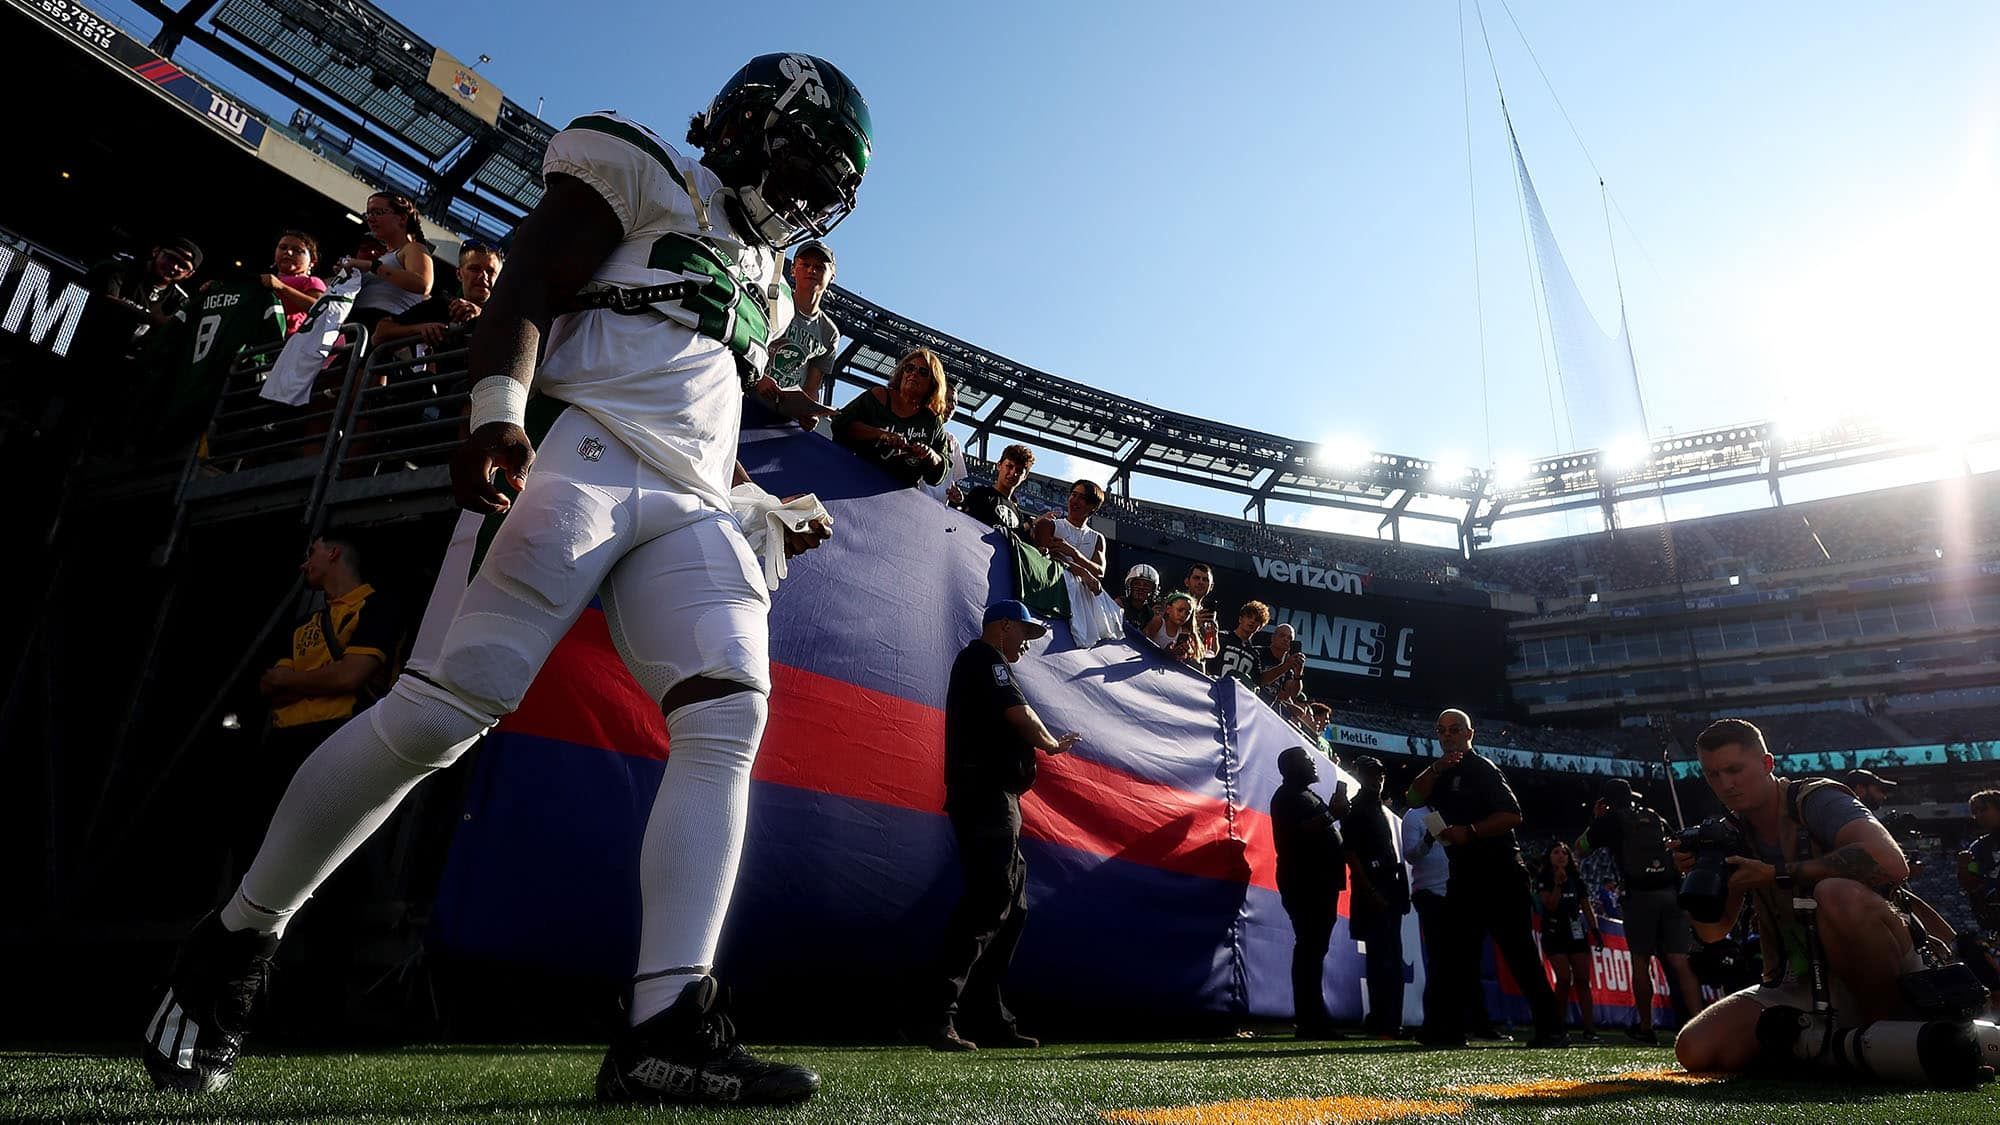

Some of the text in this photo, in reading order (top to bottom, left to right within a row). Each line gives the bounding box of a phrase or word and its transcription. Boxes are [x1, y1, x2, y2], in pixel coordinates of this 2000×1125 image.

[30, 0, 112, 49] .559.1515
[71, 6, 116, 39] 78247
[193, 314, 222, 364] 8
[1252, 555, 1363, 596] verizon
[1340, 729, 1378, 746] MetLife
